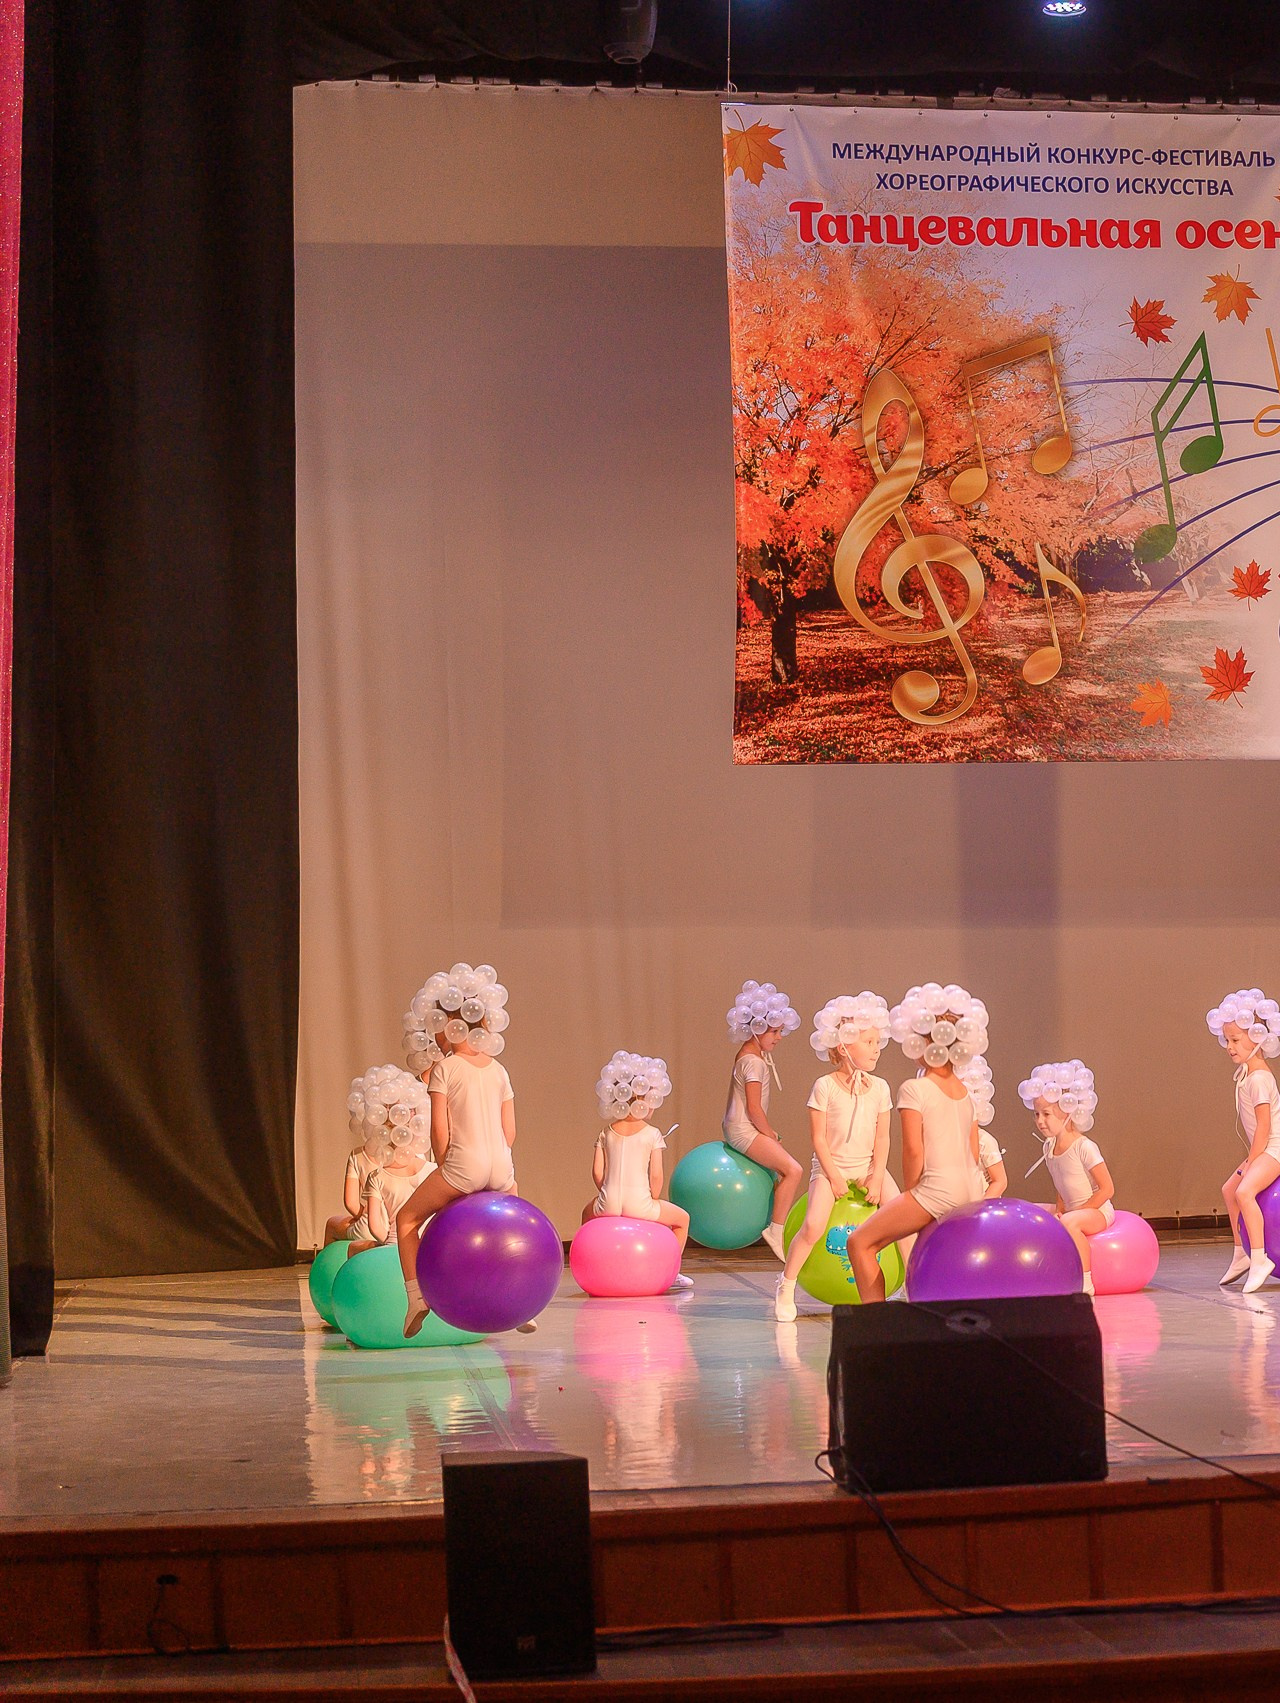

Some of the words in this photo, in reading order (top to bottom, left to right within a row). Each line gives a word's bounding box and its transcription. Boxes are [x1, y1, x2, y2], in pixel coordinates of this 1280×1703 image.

[832, 142, 1041, 166] МЕЖДУНАРОДНЫЙ
[1047, 146, 1276, 168] КОНКУРС-ФЕСТИВАЛЬ
[875, 172, 1110, 195] ХОРЕОГРАФИЧЕСКОГО
[1116, 177, 1234, 196] ИСКУССТВА
[788, 201, 1162, 252] Танцевальная
